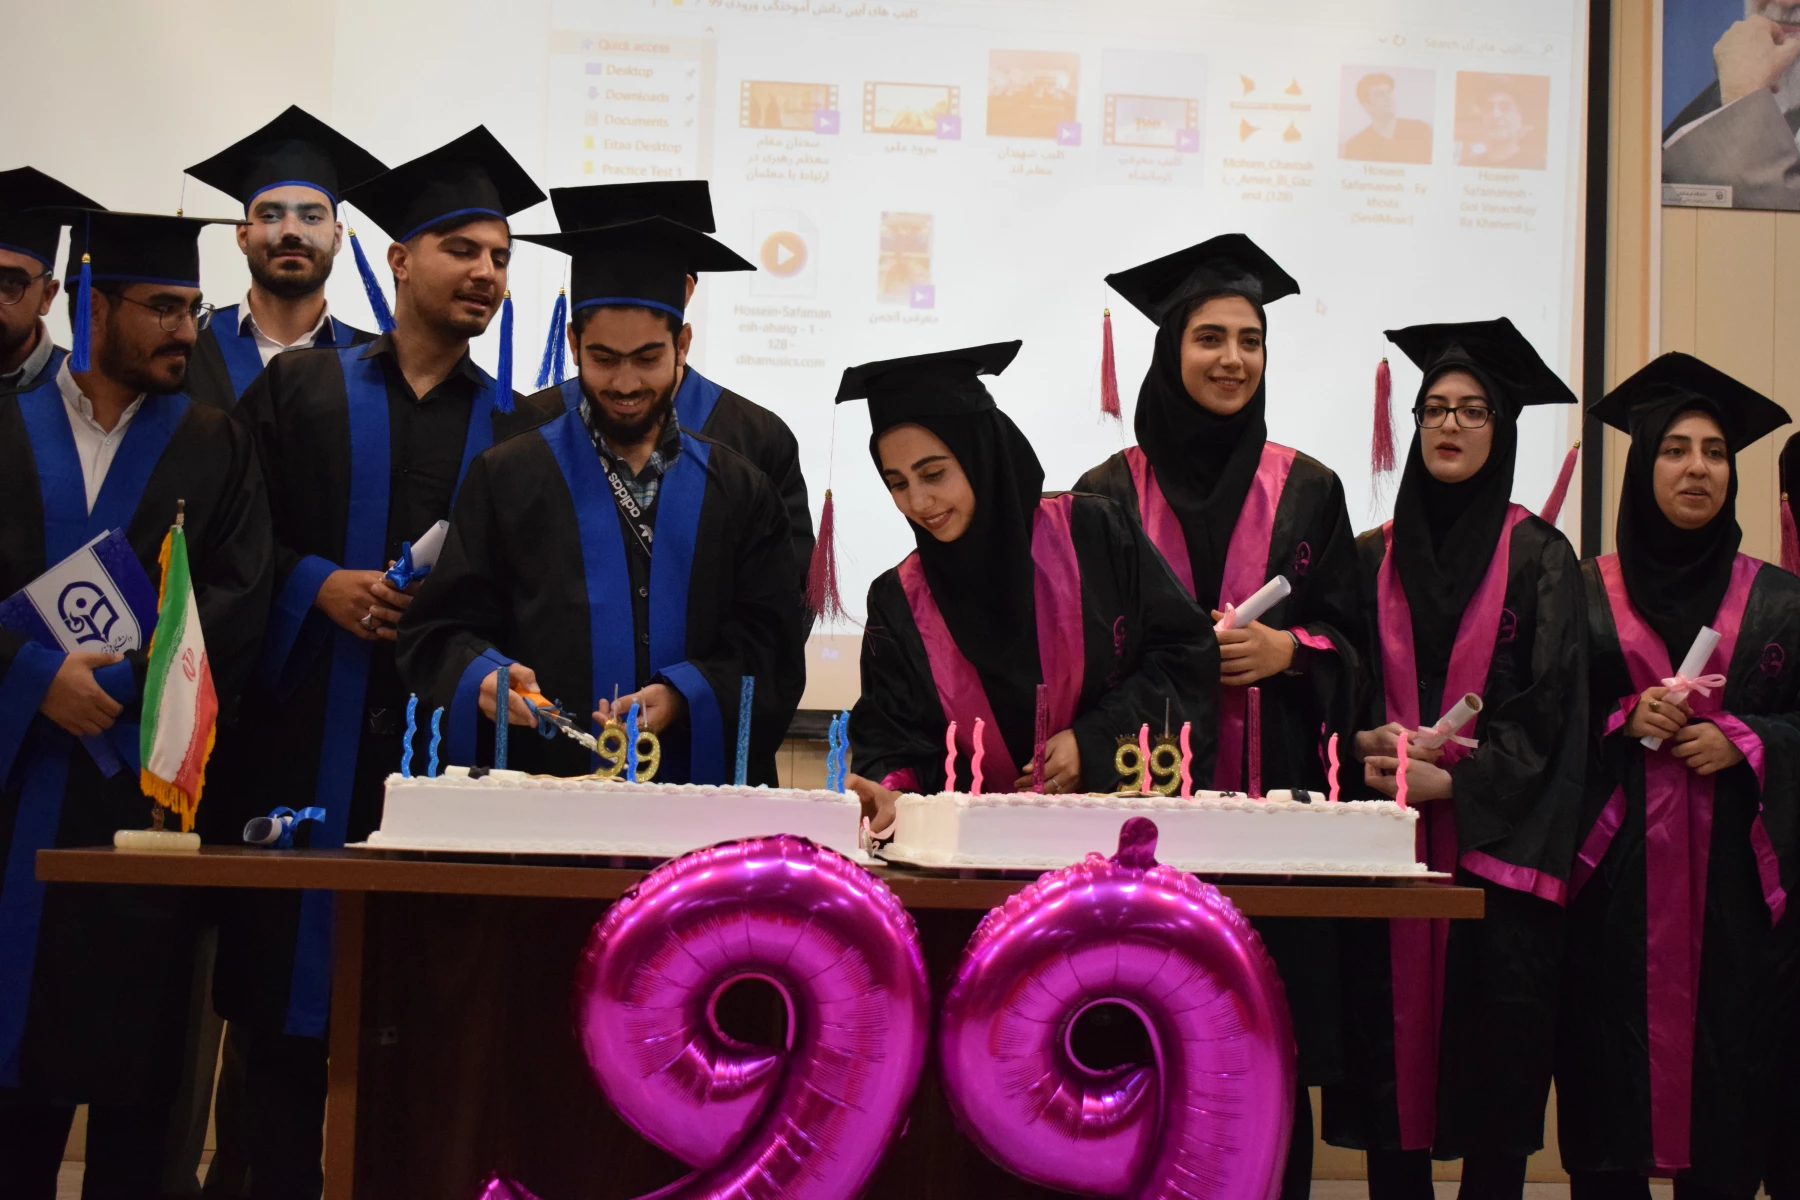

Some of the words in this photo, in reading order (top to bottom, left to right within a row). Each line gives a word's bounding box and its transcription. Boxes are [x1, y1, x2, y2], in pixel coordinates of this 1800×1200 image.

[726, 0, 758, 11] ورودی
[762, 0, 810, 14] آموختگی
[812, 4, 842, 16] دانش
[868, 7, 888, 17] های
[893, 8, 919, 20] کلیپ
[599, 39, 630, 51] Quick
[633, 42, 670, 53] access
[1424, 37, 1460, 49] Search
[606, 64, 653, 78] Desktop
[605, 88, 670, 102] Downloads
[604, 113, 669, 127] Documents
[635, 140, 682, 155] Desktop
[757, 135, 782, 147] مقام
[786, 136, 820, 149] سخنان
[884, 142, 907, 153] ملی
[912, 145, 937, 156] سرود
[1040, 149, 1064, 160] کلیپ
[748, 154, 759, 164] در
[762, 154, 793, 165] رهبری
[796, 153, 830, 165] معظم
[602, 164, 646, 176] Practice
[651, 165, 672, 177] Test
[746, 167, 784, 181] معلمان
[788, 169, 796, 180] با
[800, 169, 830, 182] ارتباط
[1364, 165, 1406, 176] Hossein
[1478, 171, 1520, 182] Hossein
[1341, 179, 1404, 192] Safamanesh
[1415, 183, 1427, 195] Ey
[1463, 185, 1526, 199] Safamanesh
[734, 304, 832, 320] Hossein-Safaman
[869, 311, 901, 325] انجمن
[902, 313, 939, 325] معرفی
[738, 321, 798, 336] esh-ahang
[767, 338, 788, 350] 128
[736, 353, 825, 369] dibamusics.com
[608, 472, 641, 518] adidas
[596, 727, 661, 783] 99
[1115, 743, 1182, 797] 99
